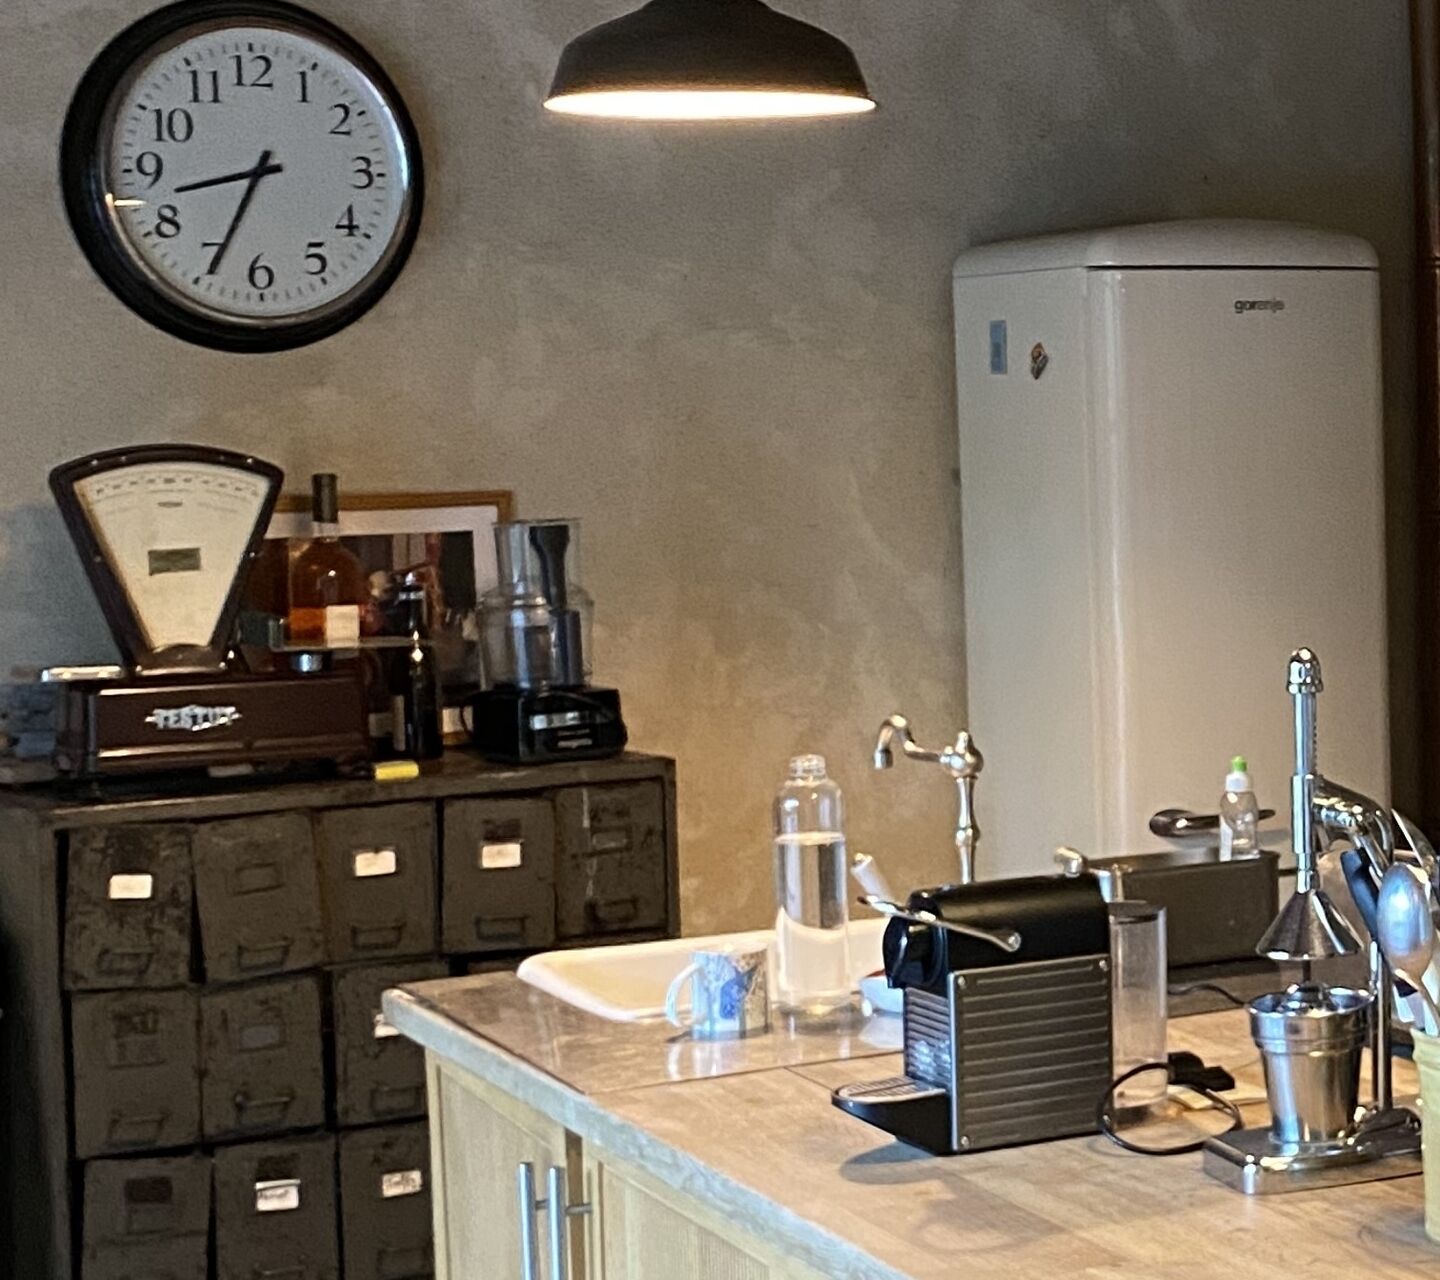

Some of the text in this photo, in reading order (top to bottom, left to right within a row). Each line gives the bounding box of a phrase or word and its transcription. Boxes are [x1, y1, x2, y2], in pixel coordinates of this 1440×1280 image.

[188, 70, 221, 104] 11
[230, 54, 274, 88] 12
[297, 70, 311, 104] 1
[153, 107, 195, 143] 10
[328, 103, 352, 136] 2
[135, 151, 164, 190] 9
[352, 156, 375, 190] 3
[155, 204, 181, 239] 8
[334, 204, 361, 238] 4
[247, 252, 275, 291] 6
[304, 242, 328, 276] 5
